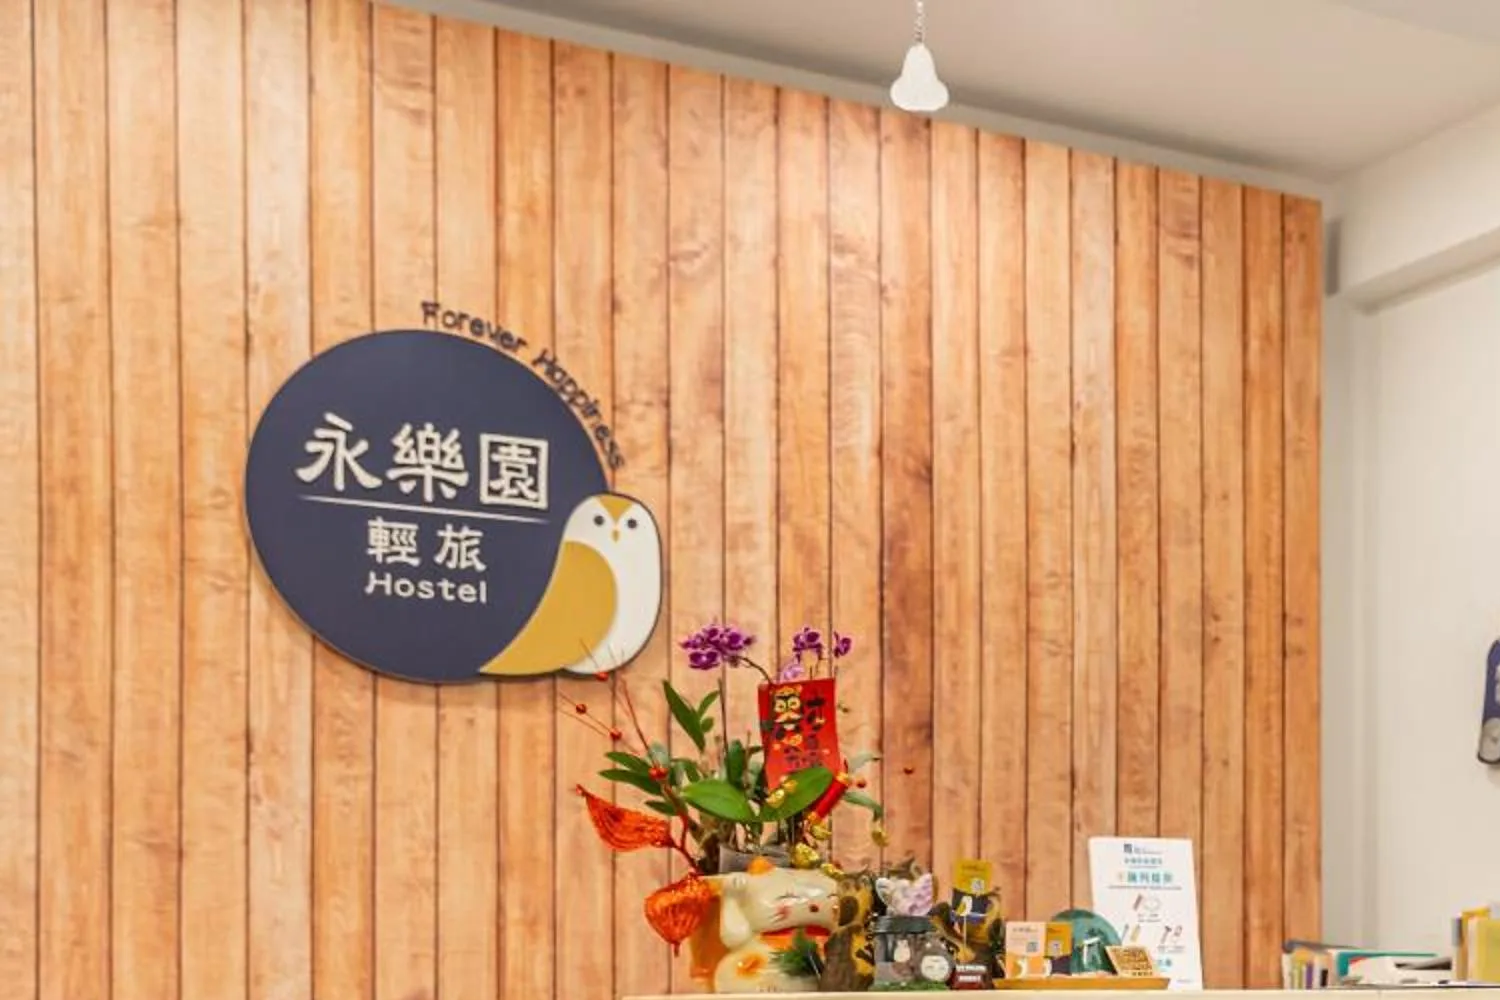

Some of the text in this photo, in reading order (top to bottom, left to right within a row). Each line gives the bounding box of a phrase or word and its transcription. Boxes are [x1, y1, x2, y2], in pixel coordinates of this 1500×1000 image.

[421, 301, 626, 470] Forever Happiness
[296, 412, 549, 509] 永樂園
[366, 516, 487, 572] 輕旅
[365, 571, 487, 603] Hostel
